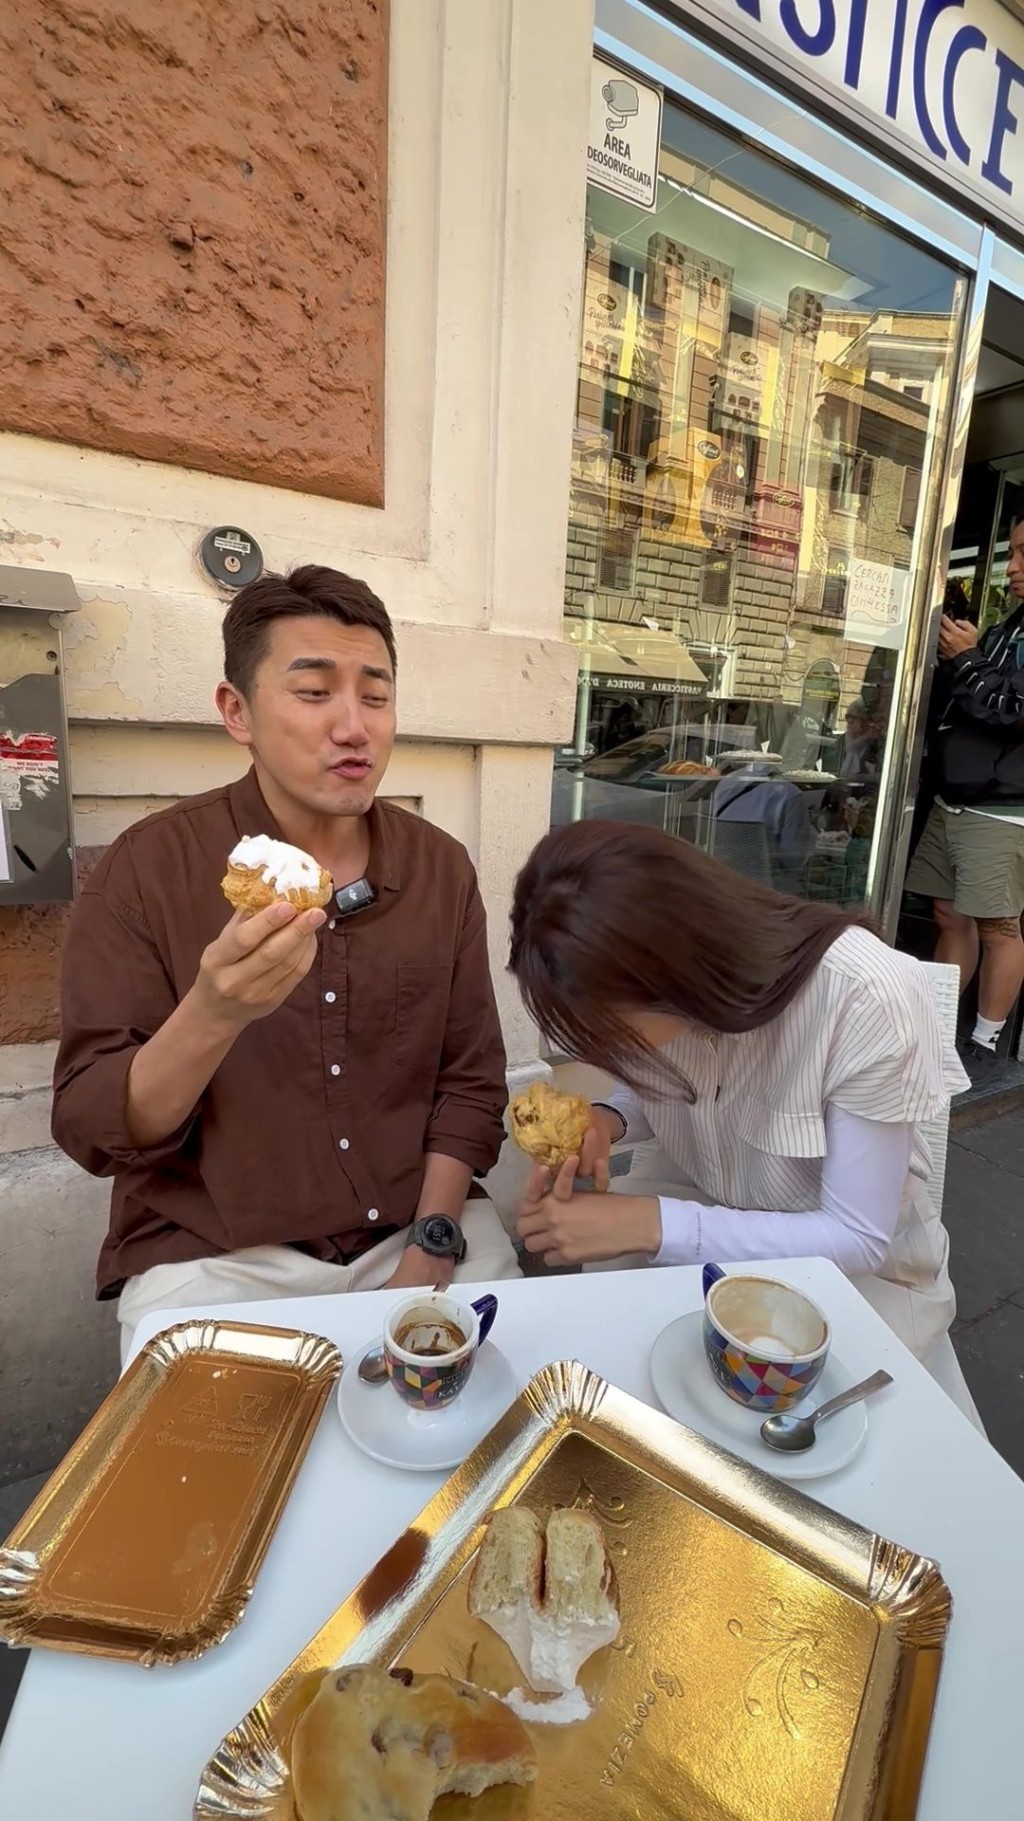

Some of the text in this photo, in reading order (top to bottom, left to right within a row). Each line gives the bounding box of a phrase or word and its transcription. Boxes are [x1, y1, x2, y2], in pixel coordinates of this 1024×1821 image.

[587, 145, 652, 189] DEOSORVEGLIATA
[604, 133, 631, 161] AREA
[600, 1687, 656, 1787] POMEZIA
